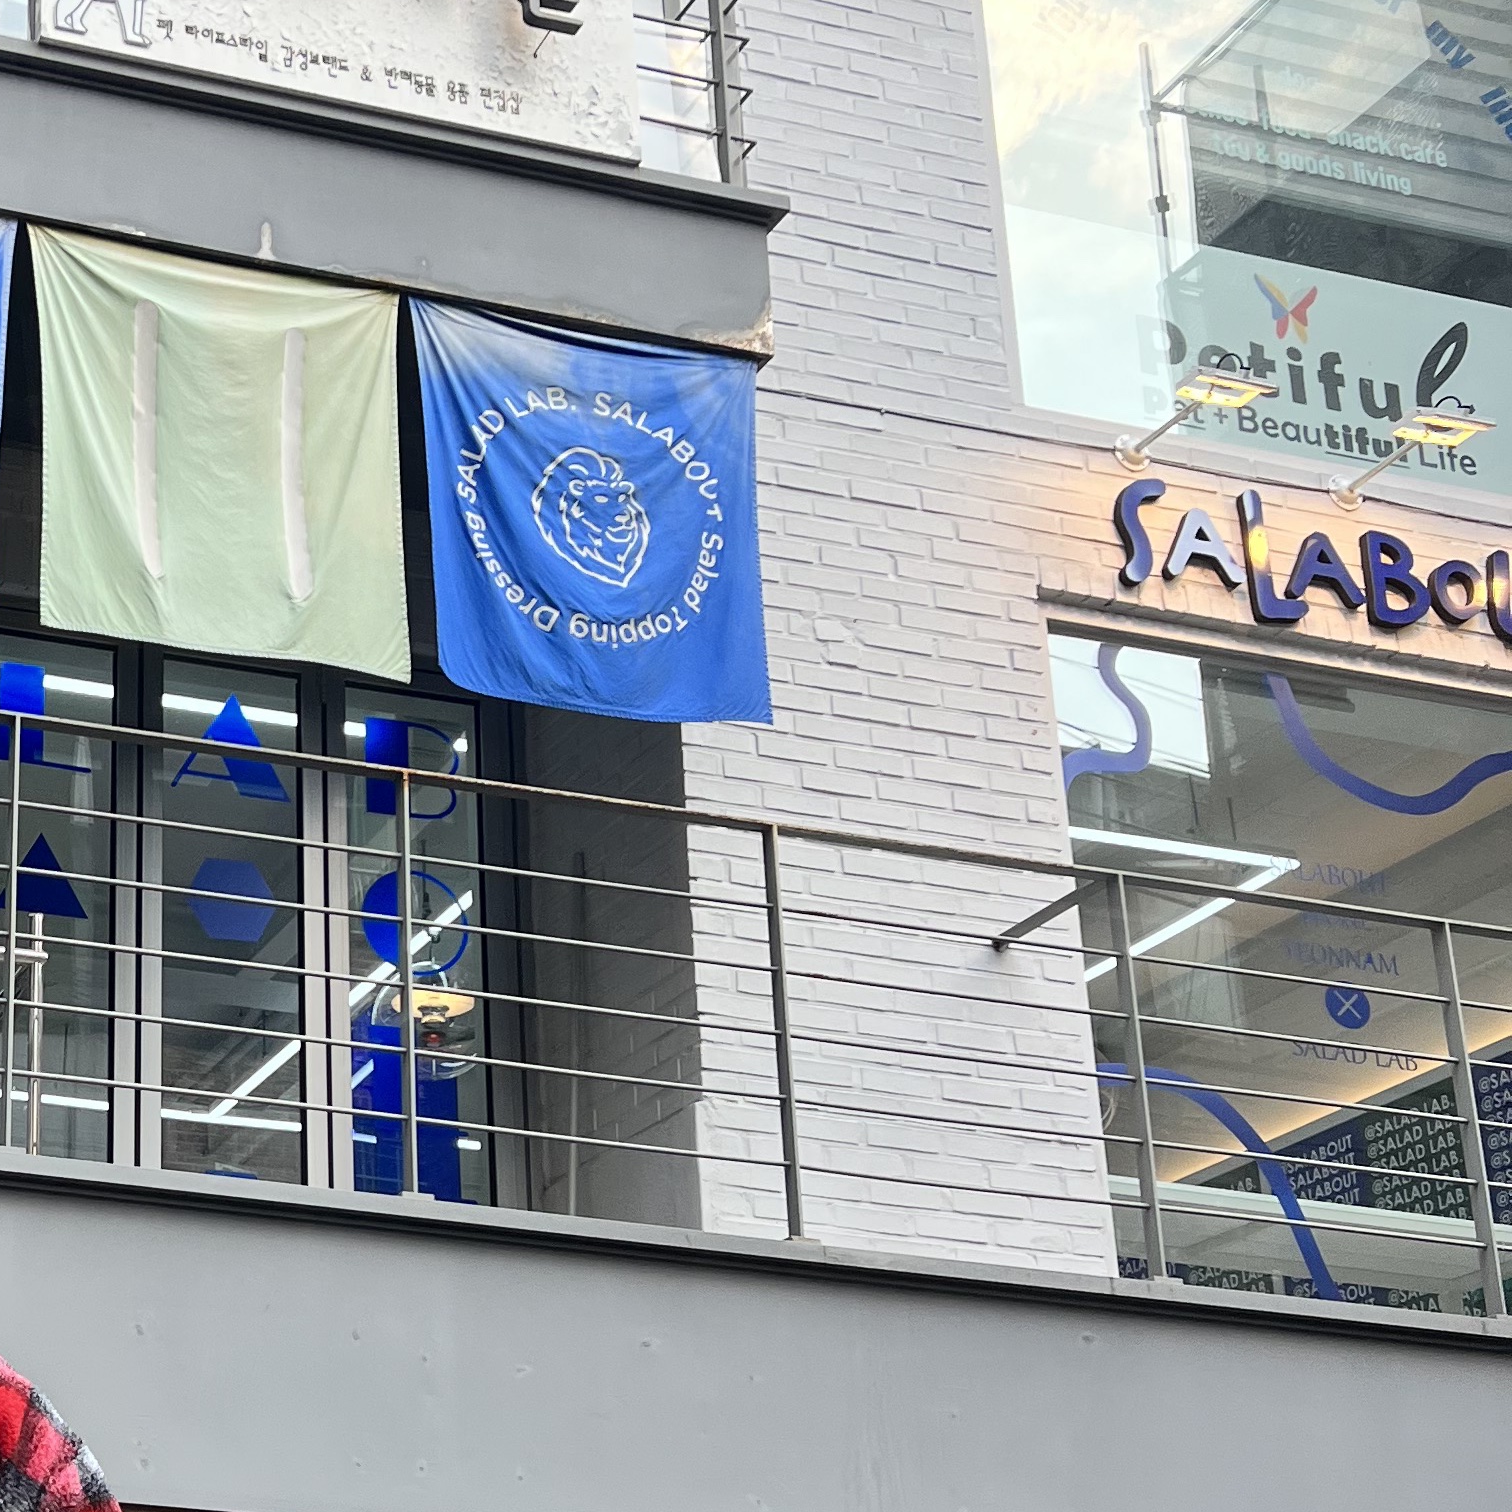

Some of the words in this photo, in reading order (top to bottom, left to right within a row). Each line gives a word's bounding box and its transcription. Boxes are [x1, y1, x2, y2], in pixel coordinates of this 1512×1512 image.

[156, 19, 173, 42] 펫
[185, 24, 268, 63] 라이프스타일
[361, 65, 373, 82] &
[384, 66, 436, 97] 반려동물
[446, 80, 469, 104] 용품
[1256, 143, 1271, 163] &
[1277, 153, 1346, 180] goods
[1353, 161, 1413, 195] living
[504, 386, 577, 418] LAB.
[456, 408, 506, 504] SALAD
[592, 391, 724, 522] SALABOUT
[1418, 444, 1478, 476] Life
[463, 511, 561, 633] Dressing
[683, 531, 725, 615] Salad
[569, 604, 690, 650] Topping
[1292, 1040, 1367, 1065] SALAD
[1375, 1051, 1418, 1072] LAB
[1367, 1125, 1423, 1159] @SALAD
[1429, 1131, 1461, 1154] LAB.
[1432, 1150, 1464, 1173] LAB.
[1439, 1188, 1470, 1211] LAB.
